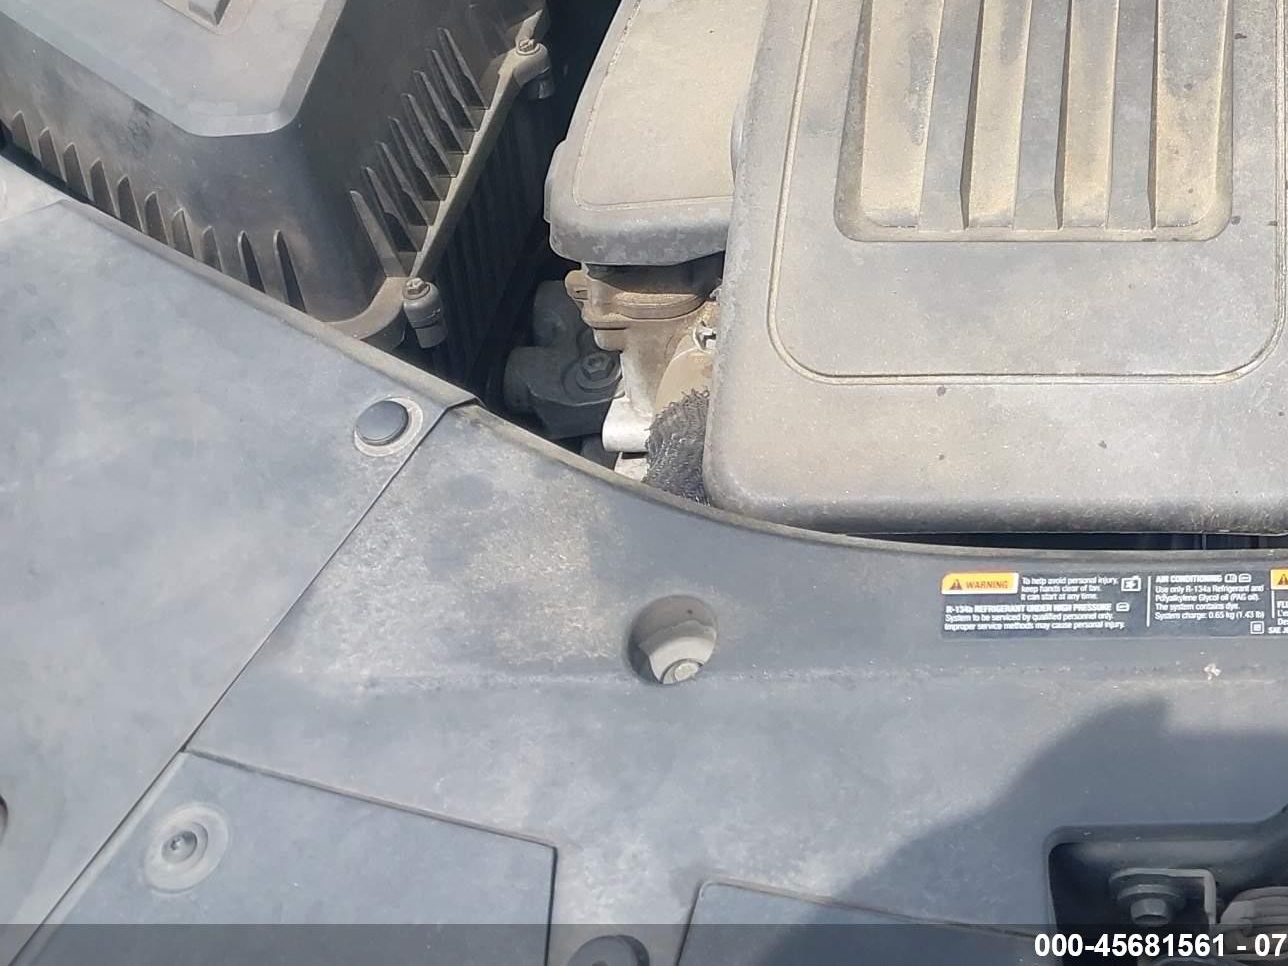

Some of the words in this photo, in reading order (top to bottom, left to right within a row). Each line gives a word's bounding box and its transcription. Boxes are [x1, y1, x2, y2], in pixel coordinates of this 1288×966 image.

[1031, 577, 1046, 586] help
[1047, 577, 1067, 585] avoid
[1067, 577, 1097, 585] personal
[1156, 575, 1169, 583] AIR
[1170, 575, 1222, 583] CONDITIONING
[965, 580, 1008, 589] WARNING
[1021, 586, 1039, 594] keep
[1040, 585, 1061, 593] hands
[1155, 585, 1169, 593] Use
[1170, 585, 1184, 594] only
[1185, 585, 1210, 593] R-134a
[1212, 584, 1249, 594] Refrigerant
[1251, 584, 1264, 592] and
[1041, 593, 1057, 601] start
[1066, 594, 1080, 602] any
[1198, 594, 1219, 603] Glycol
[1230, 593, 1246, 602] (PAG
[1247, 593, 1259, 602] oil).
[945, 605, 973, 614] R-134a
[974, 604, 1026, 614] REFRIGERANT
[1026, 604, 1052, 613] UNDER
[1053, 603, 1073, 612] HIGH
[1073, 603, 1112, 612] PRESSURE
[1169, 603, 1194, 612] system
[1225, 602, 1240, 611] dye.
[945, 614, 971, 623] System
[972, 614, 980, 622] to
[981, 614, 990, 622] be
[991, 614, 1021, 622] serviced
[1022, 614, 1031, 622] by
[1032, 613, 1061, 622] qualified
[1062, 613, 1097, 622] personnel
[1098, 613, 1113, 622] only.
[1154, 612, 1180, 621] System
[1181, 612, 1207, 621] charge:
[1208, 611, 1224, 619] 0.65
[1225, 611, 1235, 620] kg
[1235, 610, 1254, 619] (1.43
[1255, 610, 1265, 619] lb)
[944, 623, 977, 632] Improper
[977, 623, 1003, 631] service
[1003, 623, 1034, 631] methods
[1034, 622, 1051, 631] may
[1051, 622, 1072, 630] cause
[1073, 621, 1104, 630] personal
[1104, 621, 1125, 630] injury.
